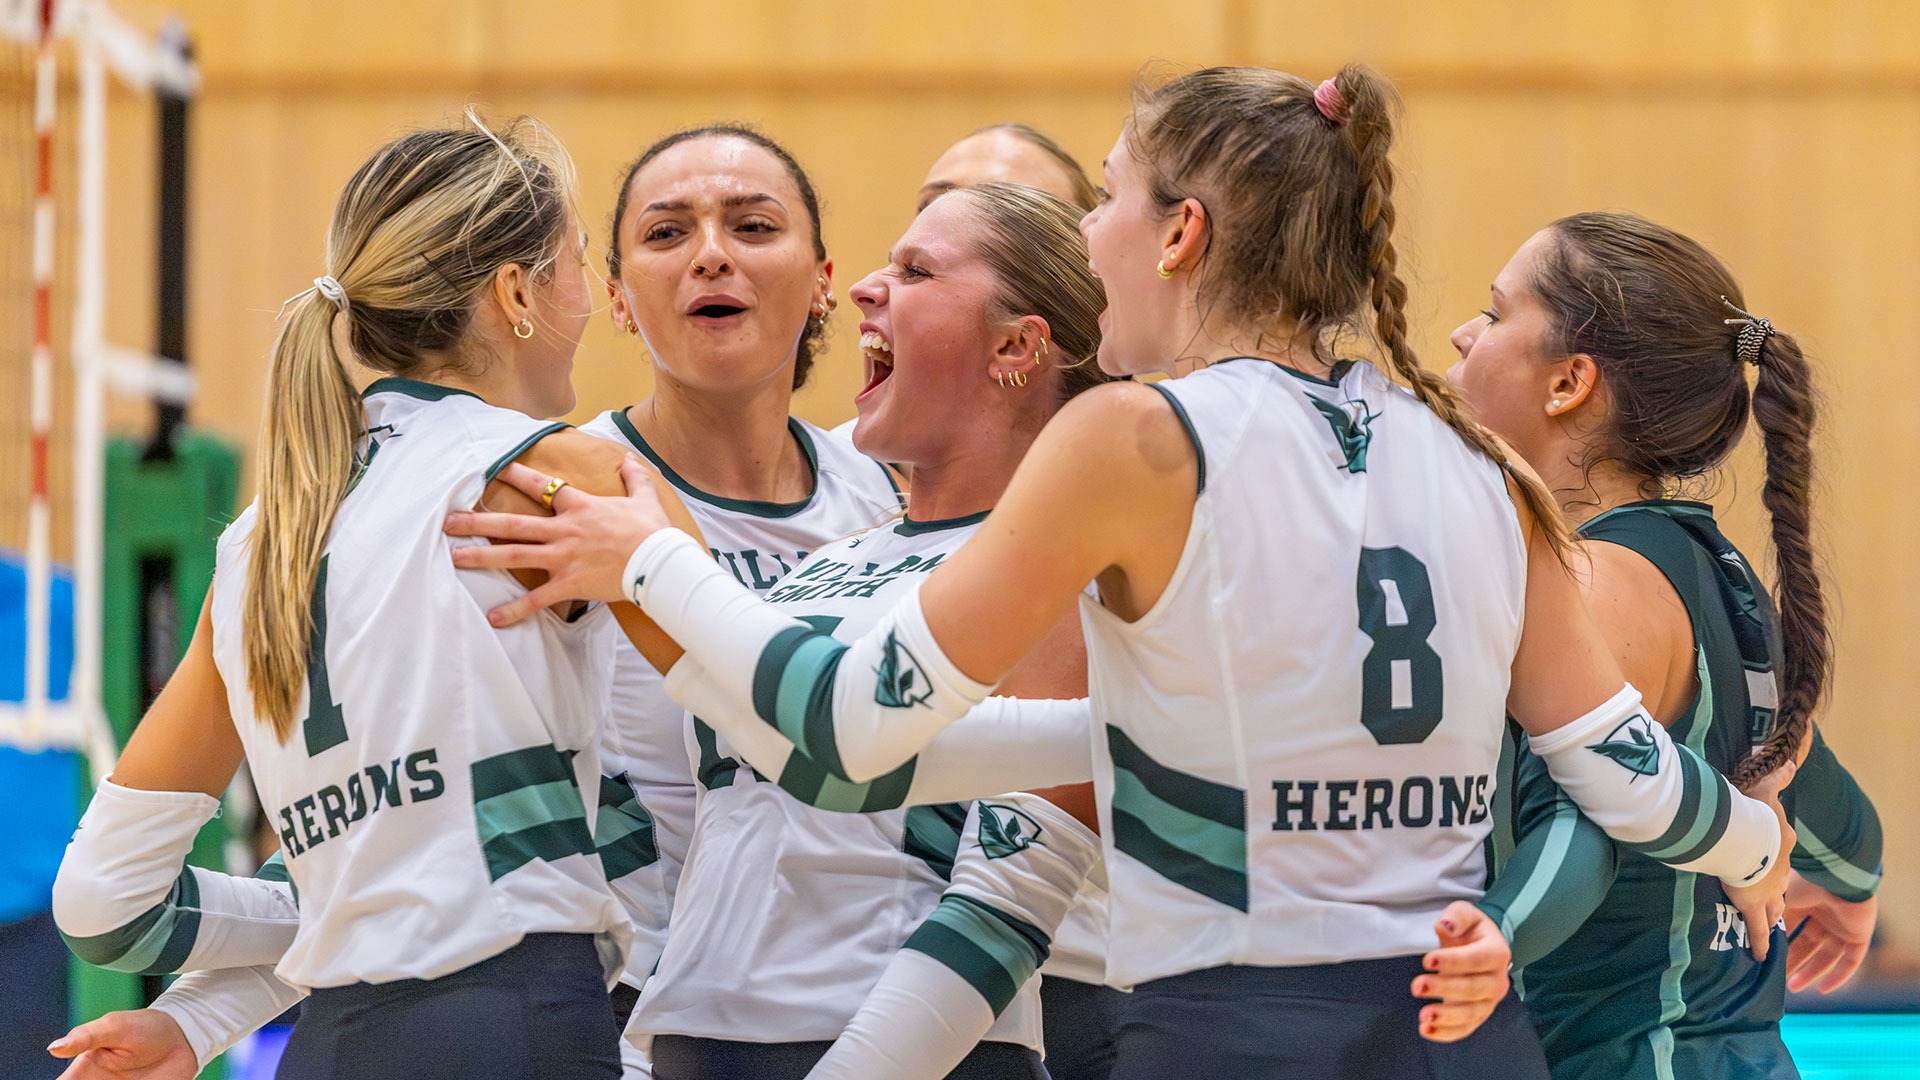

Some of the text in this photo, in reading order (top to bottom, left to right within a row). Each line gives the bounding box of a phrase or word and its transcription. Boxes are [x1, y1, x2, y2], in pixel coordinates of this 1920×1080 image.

[762, 576, 899, 603] SMITH
[1356, 545, 1444, 746] 8
[278, 747, 446, 859] HERONS
[1271, 774, 1489, 831] HERONS
